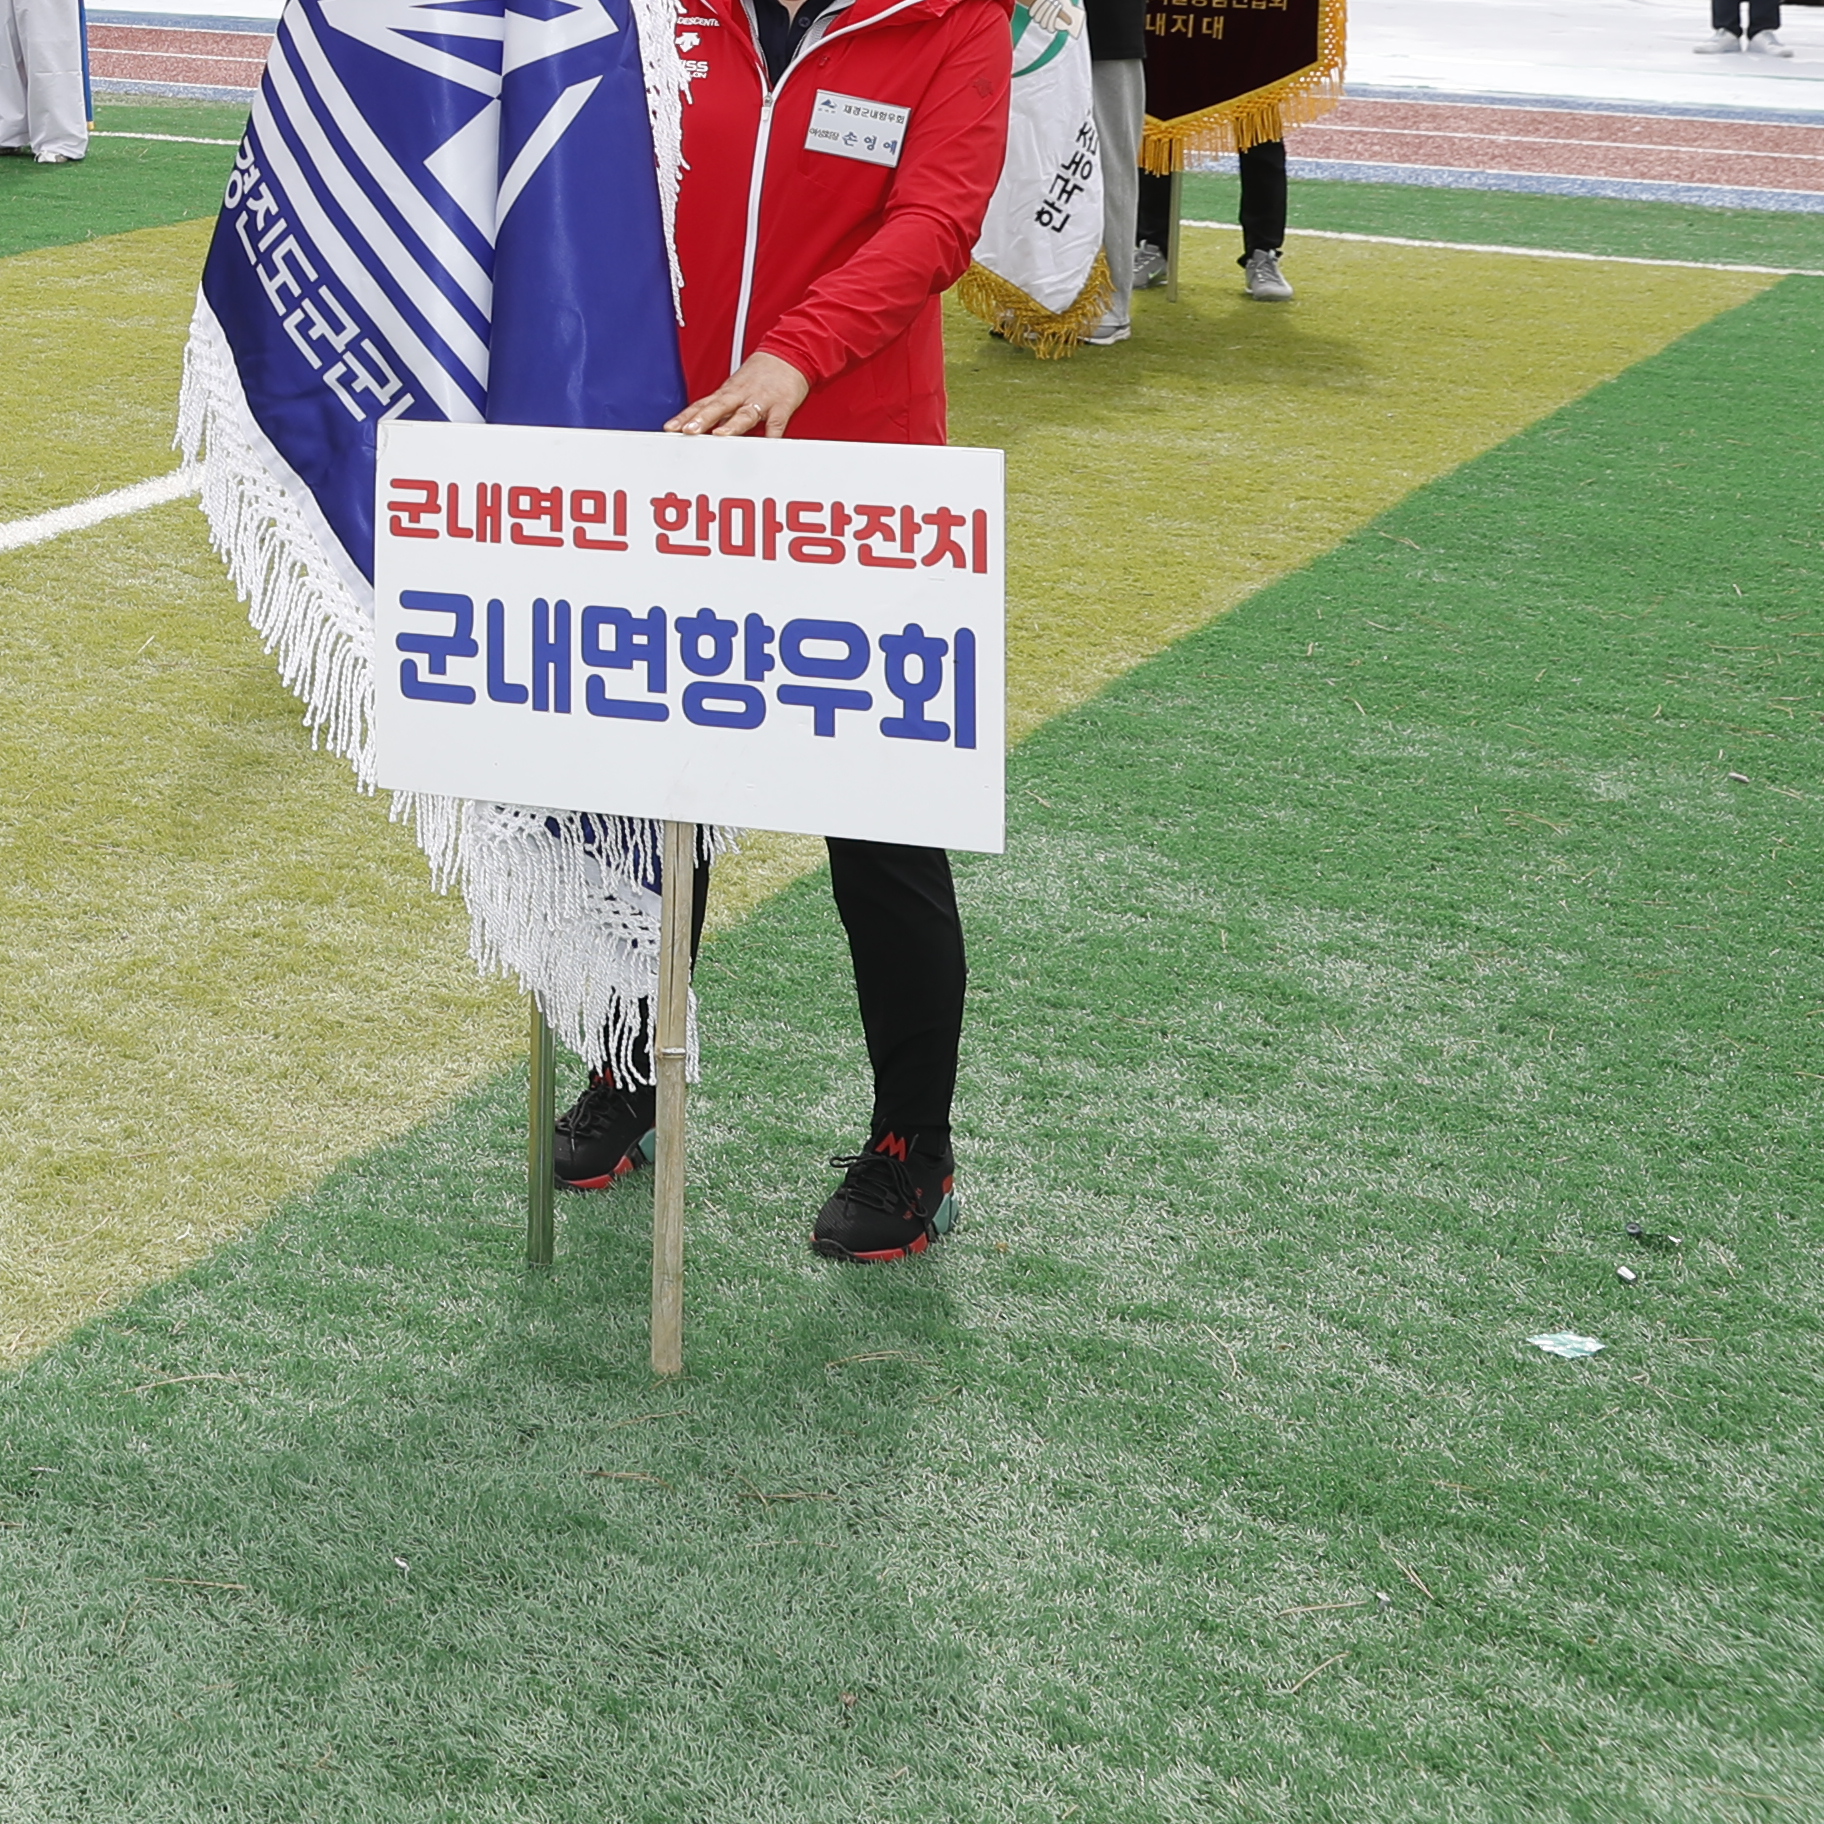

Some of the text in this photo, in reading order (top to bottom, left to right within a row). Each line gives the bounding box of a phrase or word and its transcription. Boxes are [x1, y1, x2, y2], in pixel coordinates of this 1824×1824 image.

[386, 478, 989, 575] 군내면민 한마당잔치
[395, 589, 977, 749] 군내면향우회
